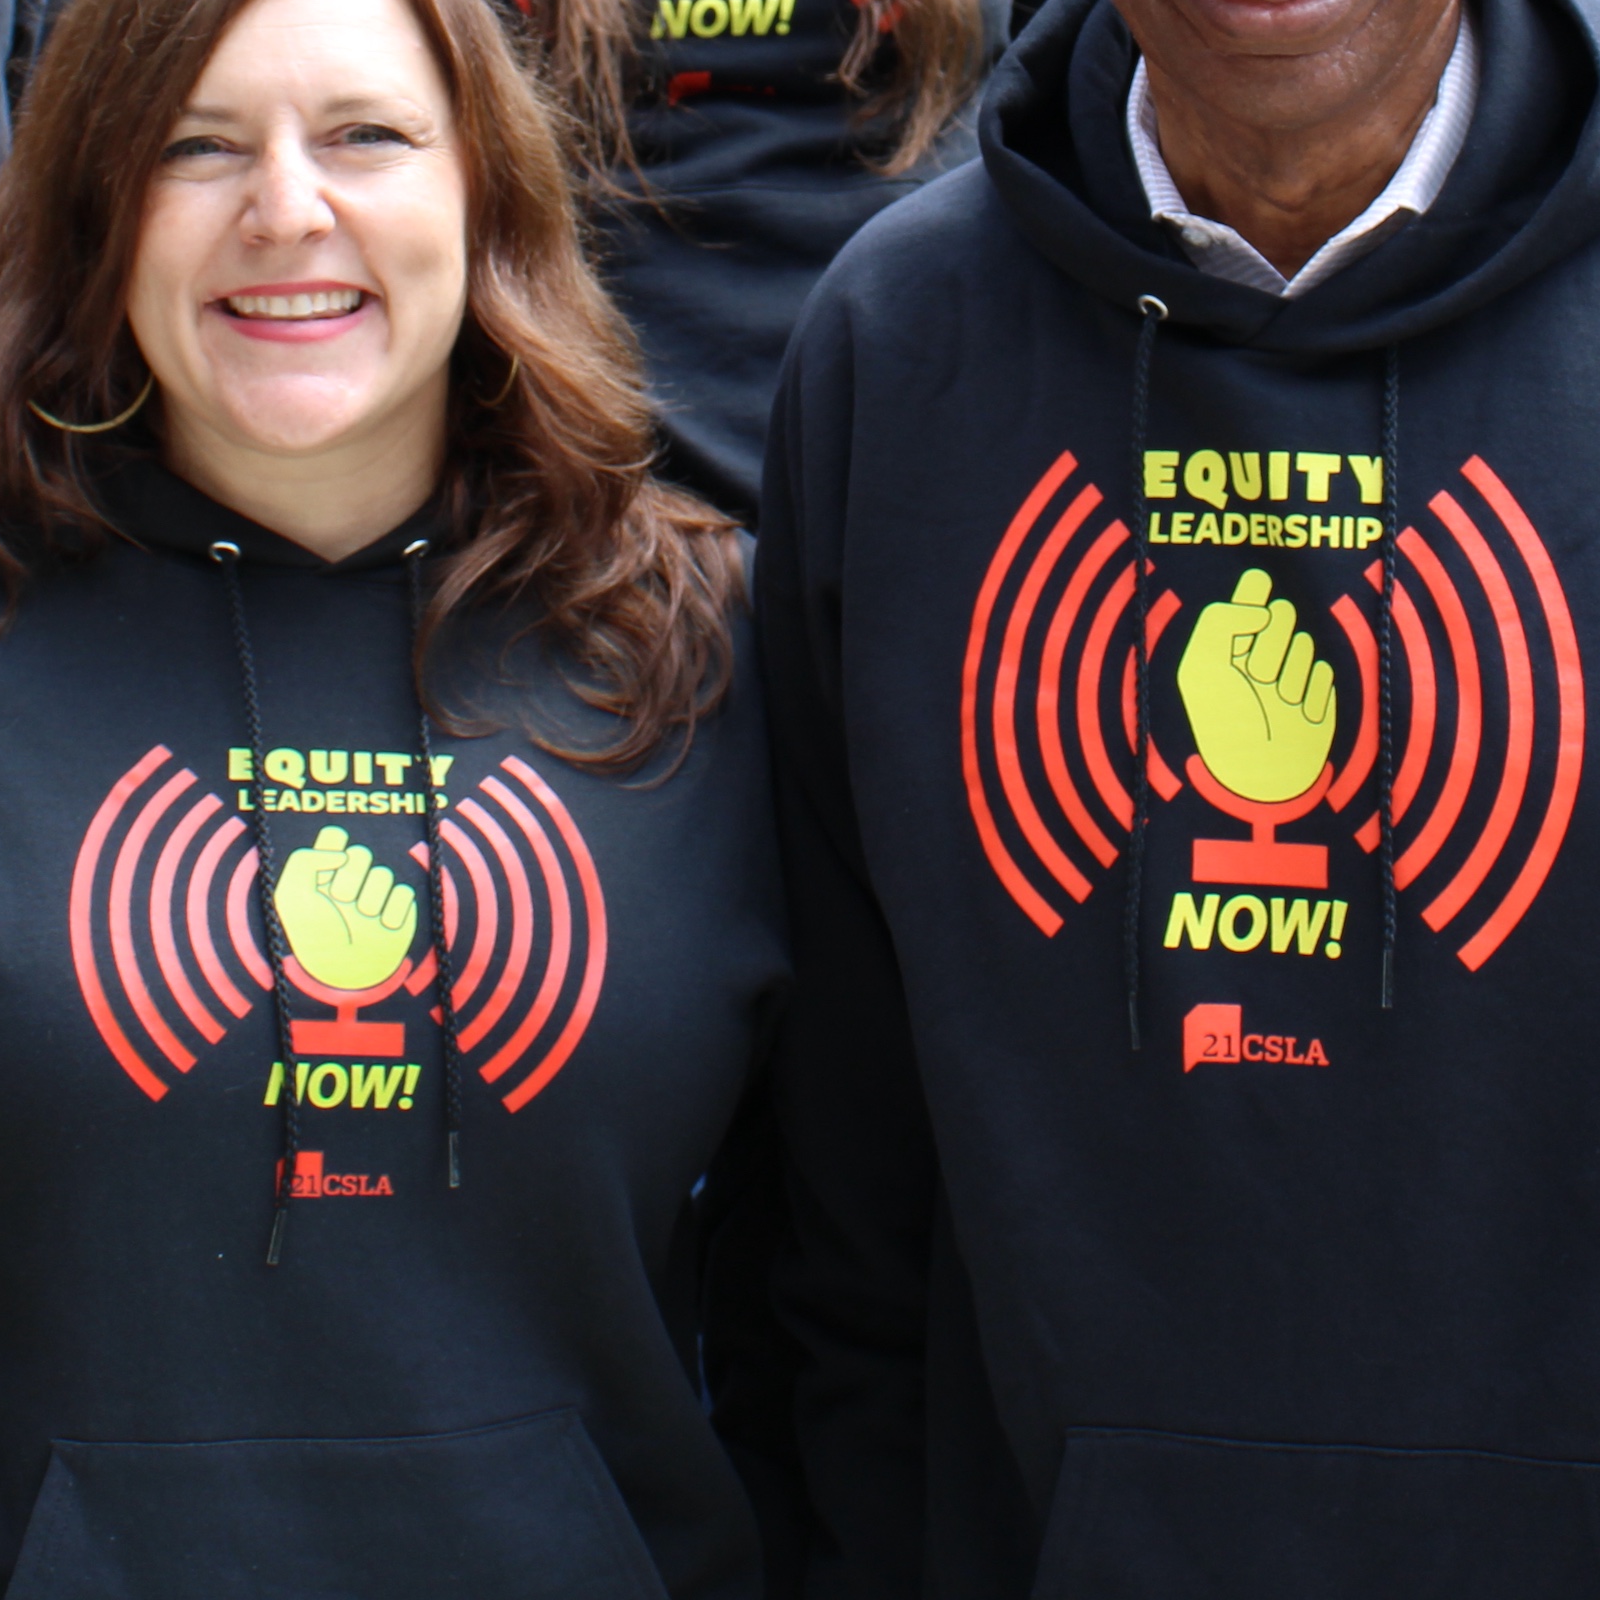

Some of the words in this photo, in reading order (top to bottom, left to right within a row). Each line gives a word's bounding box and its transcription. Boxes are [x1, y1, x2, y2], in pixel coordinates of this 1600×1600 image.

[1144, 450, 1384, 510] EQUITY
[1149, 513, 1384, 550] LEADERSHIP
[1163, 892, 1348, 959] NOW!
[1202, 1034, 1330, 1066] 21CSLA
[263, 1062, 421, 1110] NOW!
